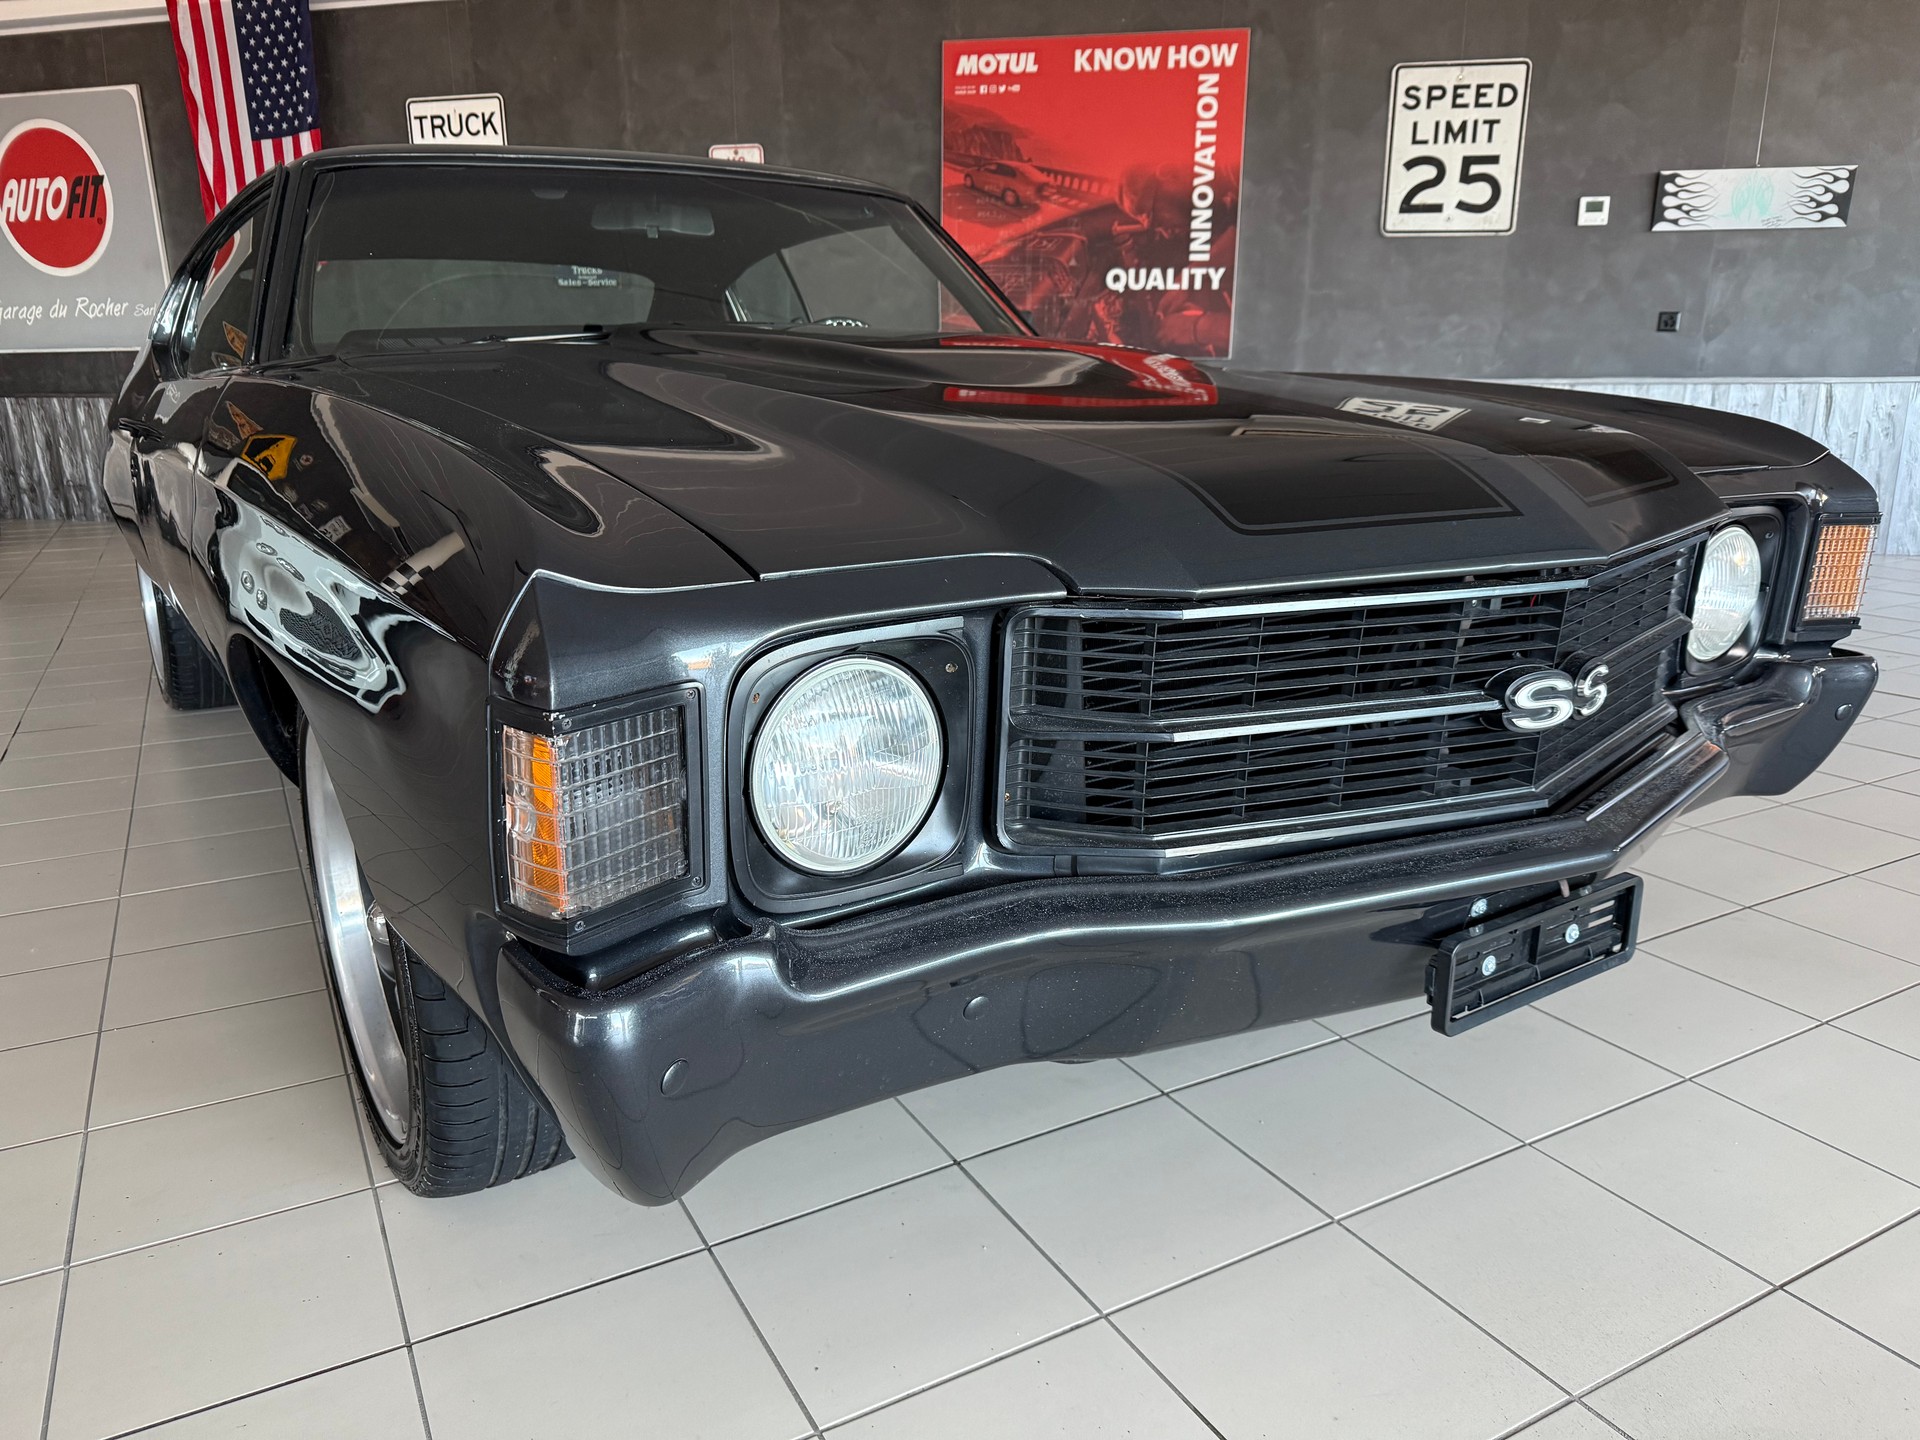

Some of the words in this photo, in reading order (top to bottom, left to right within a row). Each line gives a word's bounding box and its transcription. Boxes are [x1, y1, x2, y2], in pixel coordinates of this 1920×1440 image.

[955, 52, 1039, 76] MOTUL
[1074, 46, 1162, 73] KNOW
[1167, 43, 1239, 70] HOW
[1402, 82, 1518, 110] SPEED
[413, 111, 499, 139] TRUCK
[1411, 119, 1501, 145] LIMIT
[1188, 73, 1220, 262] INNOVATION
[2, 175, 104, 222] AUTOFIT
[1399, 155, 1501, 214] 25
[1105, 267, 1226, 293] QUALITY
[50, 299, 68, 318] du
[75, 297, 129, 319] Rocher
[133, 302, 157, 317] Sarl
[1503, 664, 1609, 732] SS
